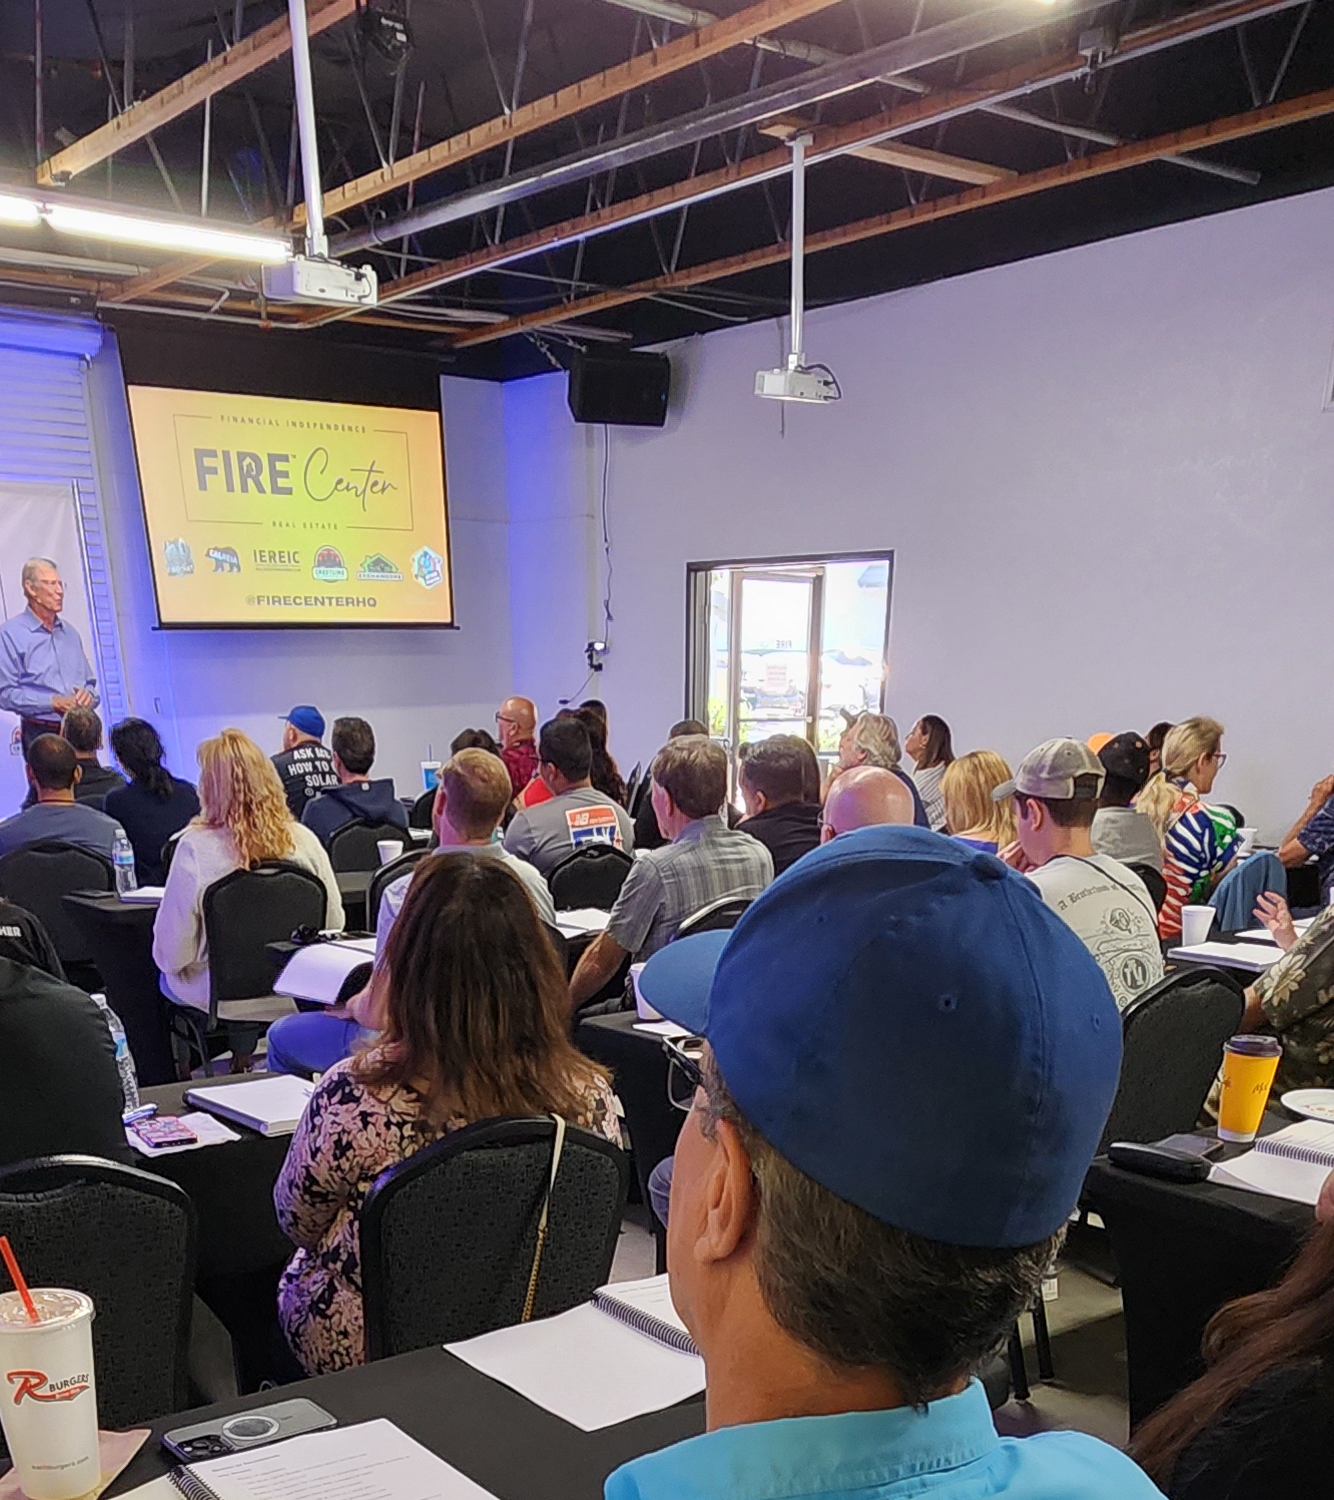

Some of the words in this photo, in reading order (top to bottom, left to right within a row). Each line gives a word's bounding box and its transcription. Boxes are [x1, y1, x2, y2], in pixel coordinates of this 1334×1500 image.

[220, 415, 280, 427] FINANCIAL
[286, 420, 366, 434] INDEPENDENCE
[303, 446, 398, 512] Center
[271, 520, 297, 528] REAL
[302, 521, 338, 530] ESTATE
[253, 549, 300, 564] IEREIC
[245, 595, 378, 609] @FIRECENTERHQ
[293, 747, 315, 760] ASK
[287, 761, 314, 776] HOW
[314, 760, 330, 772] TO
[304, 774, 339, 787] SOLAR
[48, 1373, 90, 1393] BURGERS
